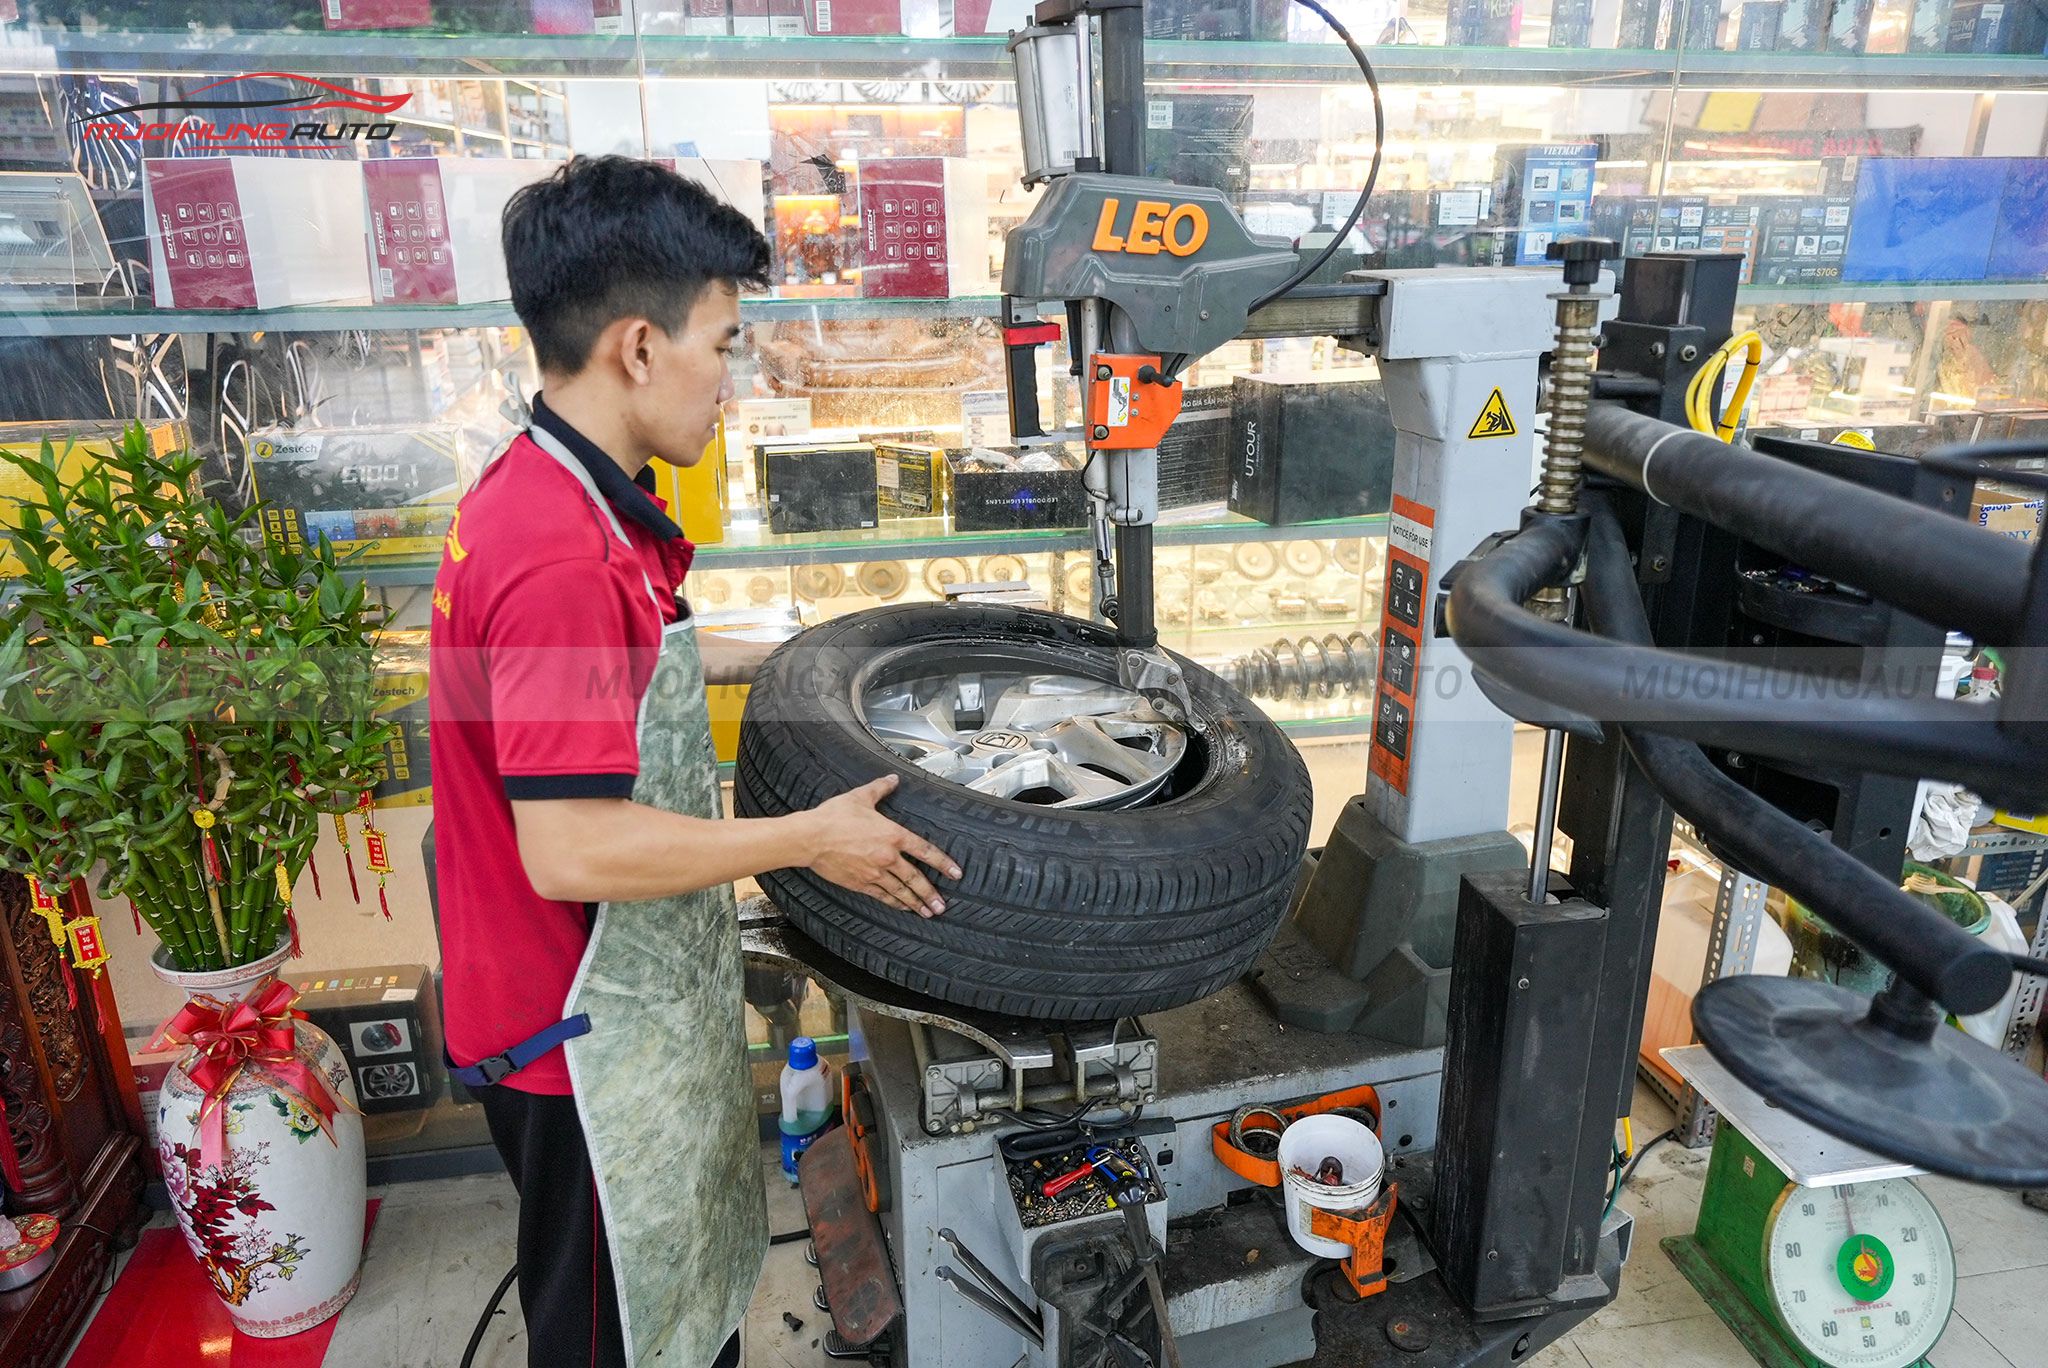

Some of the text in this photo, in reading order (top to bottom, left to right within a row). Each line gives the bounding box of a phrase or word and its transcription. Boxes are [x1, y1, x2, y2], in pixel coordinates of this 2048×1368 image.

[1092, 198, 1210, 258] LEO
[1245, 421, 1257, 477] UTOUR
[1393, 525, 1429, 548] NOTICE FOR USE
[1876, 1194, 1889, 1208] 10
[1802, 1203, 1816, 1217] 90
[1901, 1227, 1918, 1243] 20
[1785, 1242, 1802, 1259] 80
[1912, 1273, 1926, 1286] 30
[1792, 1290, 1806, 1303] 70
[1894, 1310, 1911, 1326] 40
[1821, 1321, 1838, 1338] 60
[1862, 1335, 1876, 1348] 50
